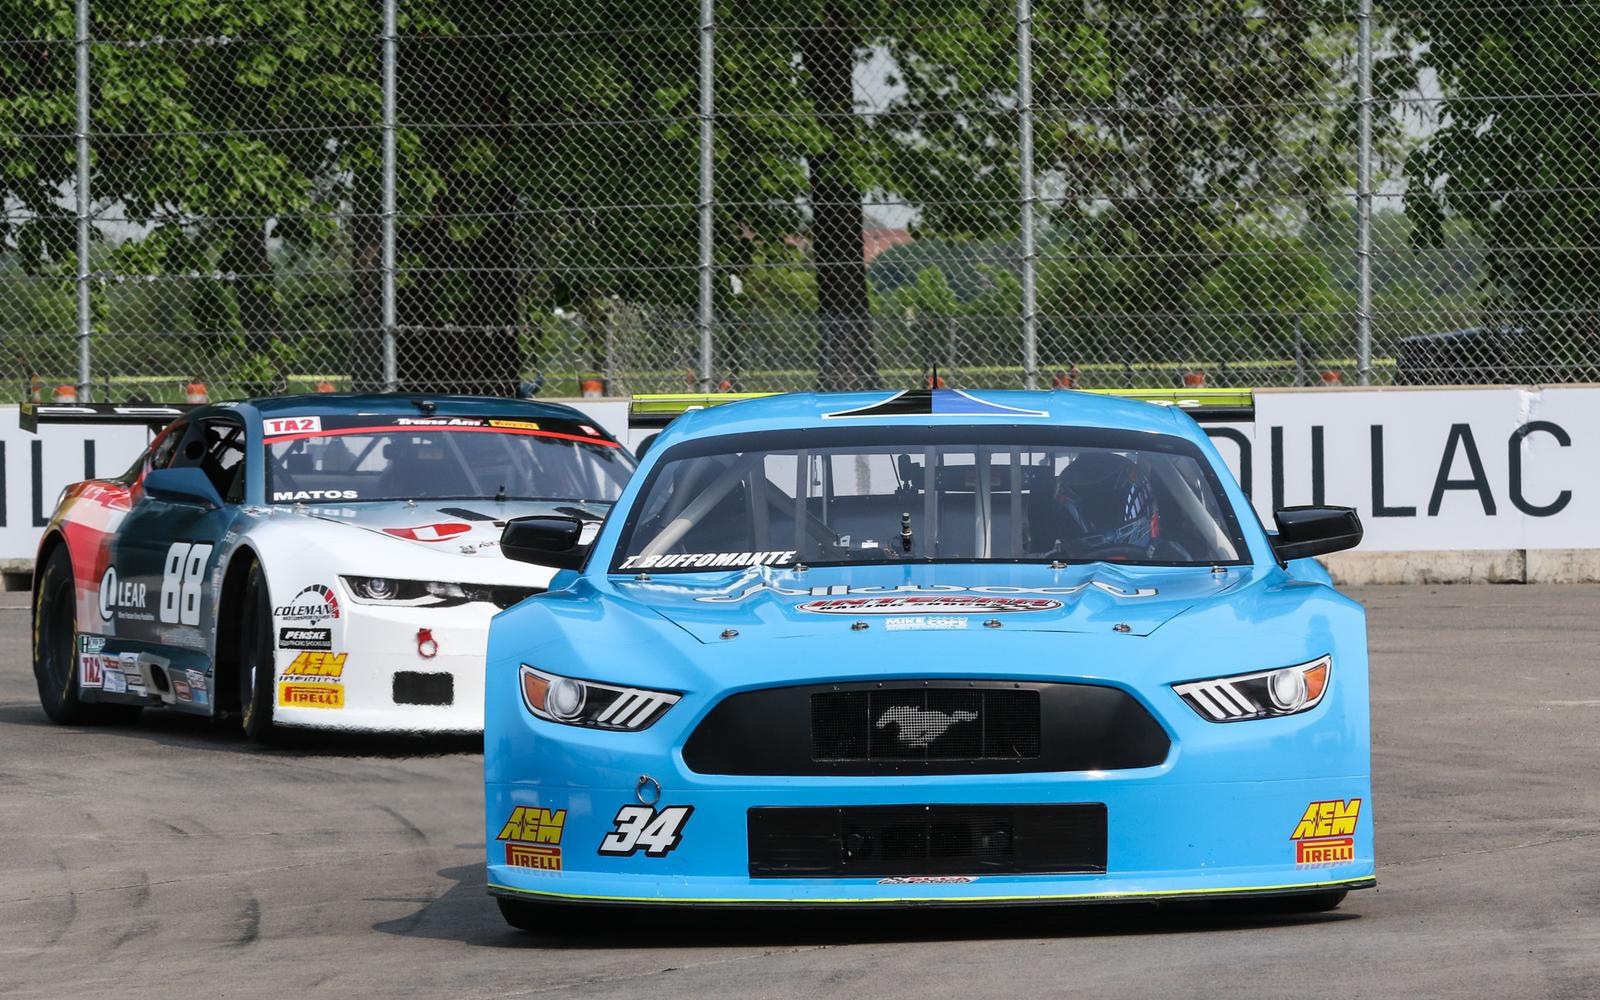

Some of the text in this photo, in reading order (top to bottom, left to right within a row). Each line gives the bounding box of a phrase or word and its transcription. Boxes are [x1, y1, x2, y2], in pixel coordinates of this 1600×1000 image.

[270, 419, 315, 432] TA2
[394, 418, 481, 426] Trans Am
[273, 490, 359, 501] MATOS
[640, 550, 797, 569] BUFFOMANTE
[118, 582, 146, 608] LEAR
[160, 542, 213, 626] 88
[273, 604, 334, 616] COLEMAN
[886, 616, 926, 625] MIKE
[285, 631, 327, 640] PENSKE
[82, 656, 100, 683] TA2
[283, 651, 348, 677] AEM
[284, 686, 339, 705] PIRELLI
[496, 806, 567, 845] AEM
[597, 804, 695, 858] 34
[1290, 798, 1362, 840] AEM
[505, 842, 562, 871] PIRELLI
[1296, 838, 1354, 864] PIRELLI
